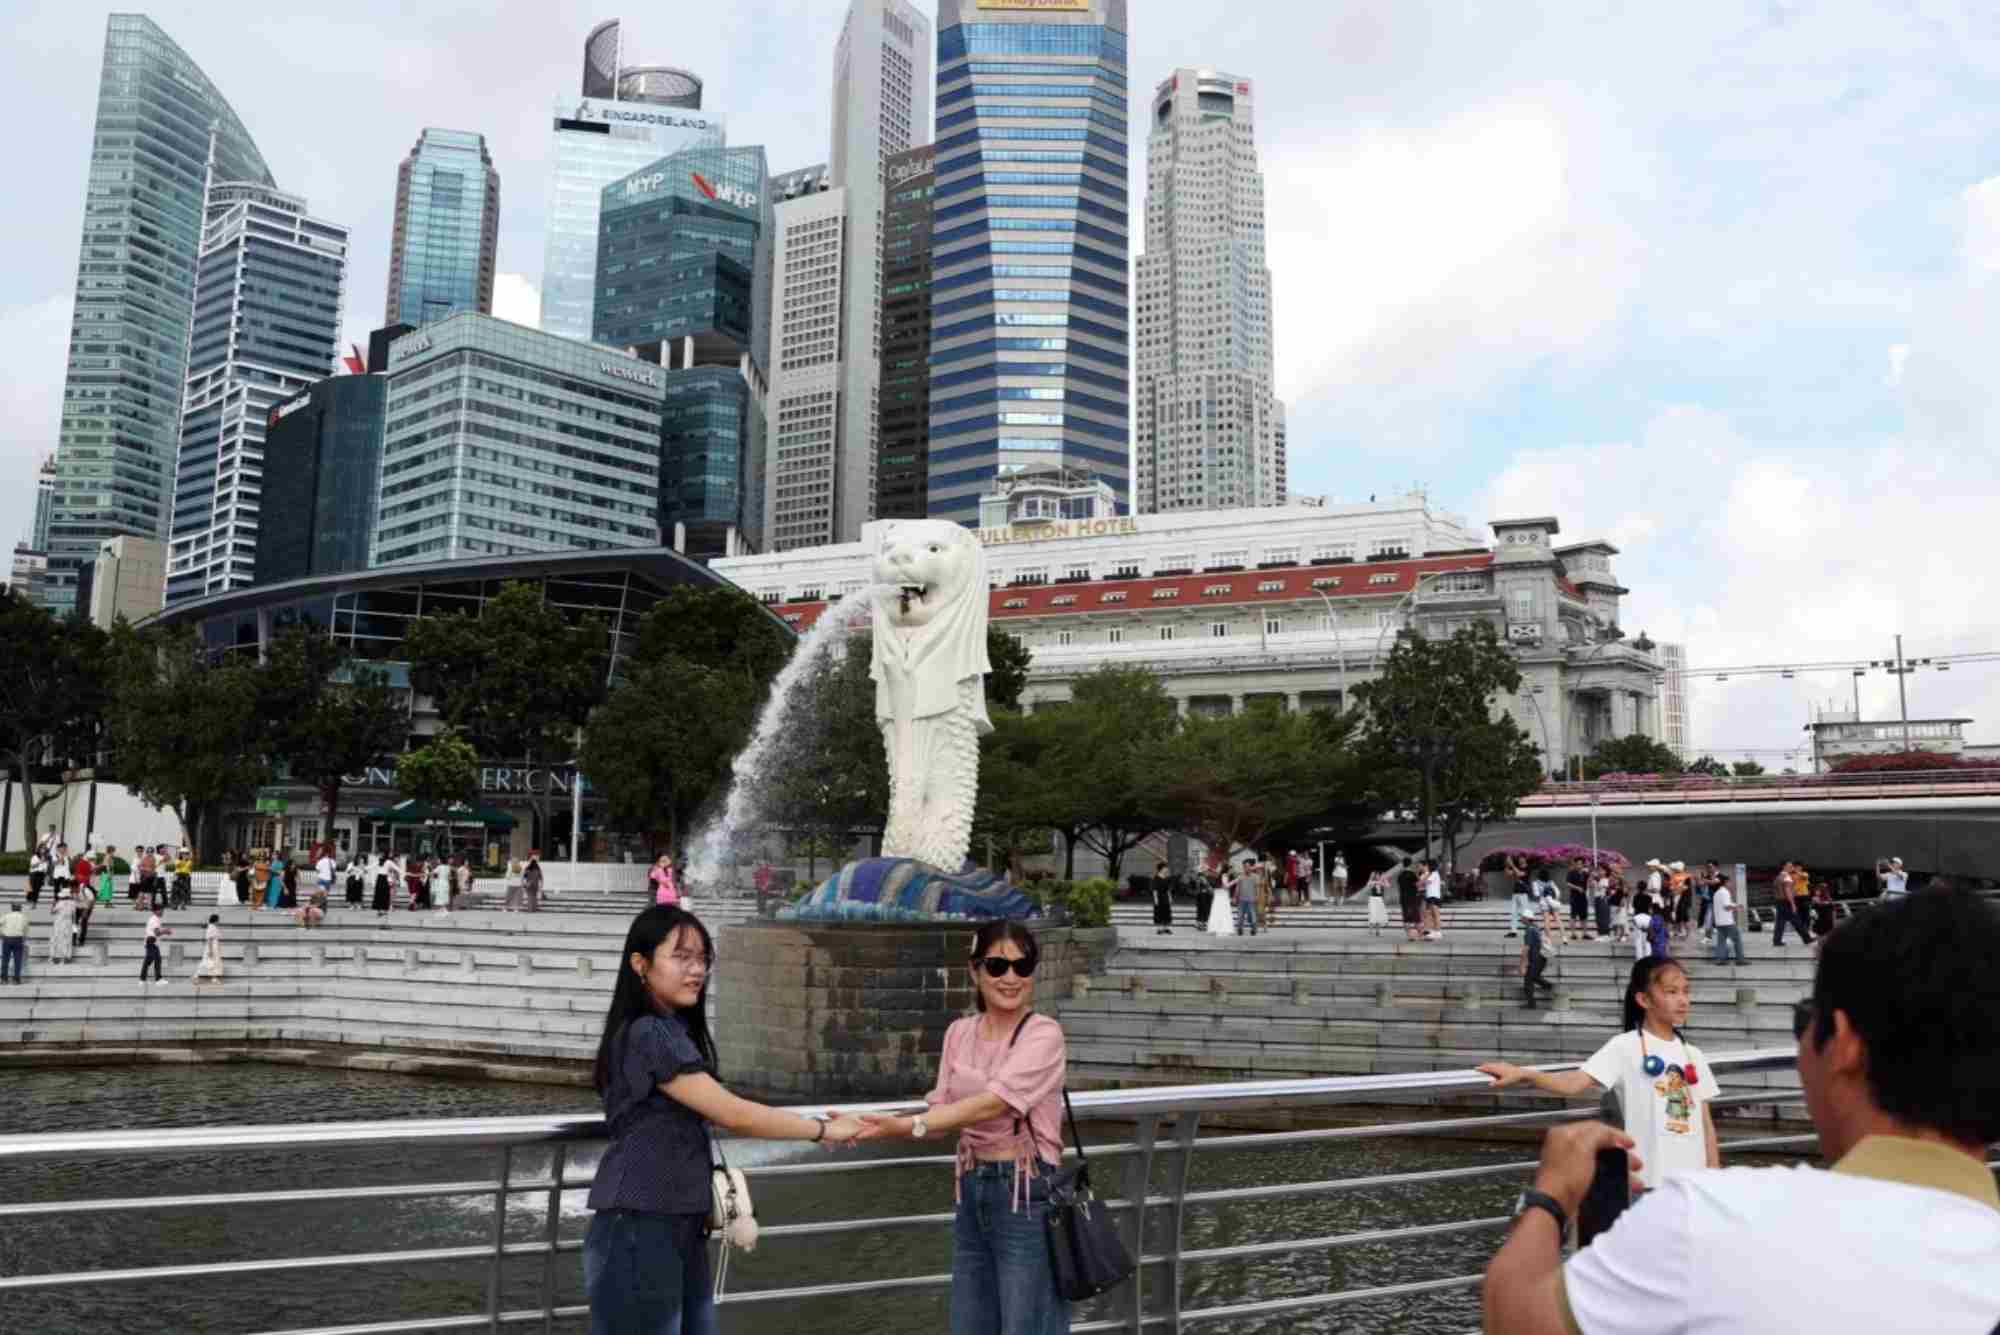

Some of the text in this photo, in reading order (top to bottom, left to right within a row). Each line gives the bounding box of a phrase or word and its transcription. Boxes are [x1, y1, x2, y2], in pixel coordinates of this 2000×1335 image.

[625, 172, 664, 195] MYP
[715, 182, 757, 209] MYP
[1078, 517, 1137, 536] HOTEL
